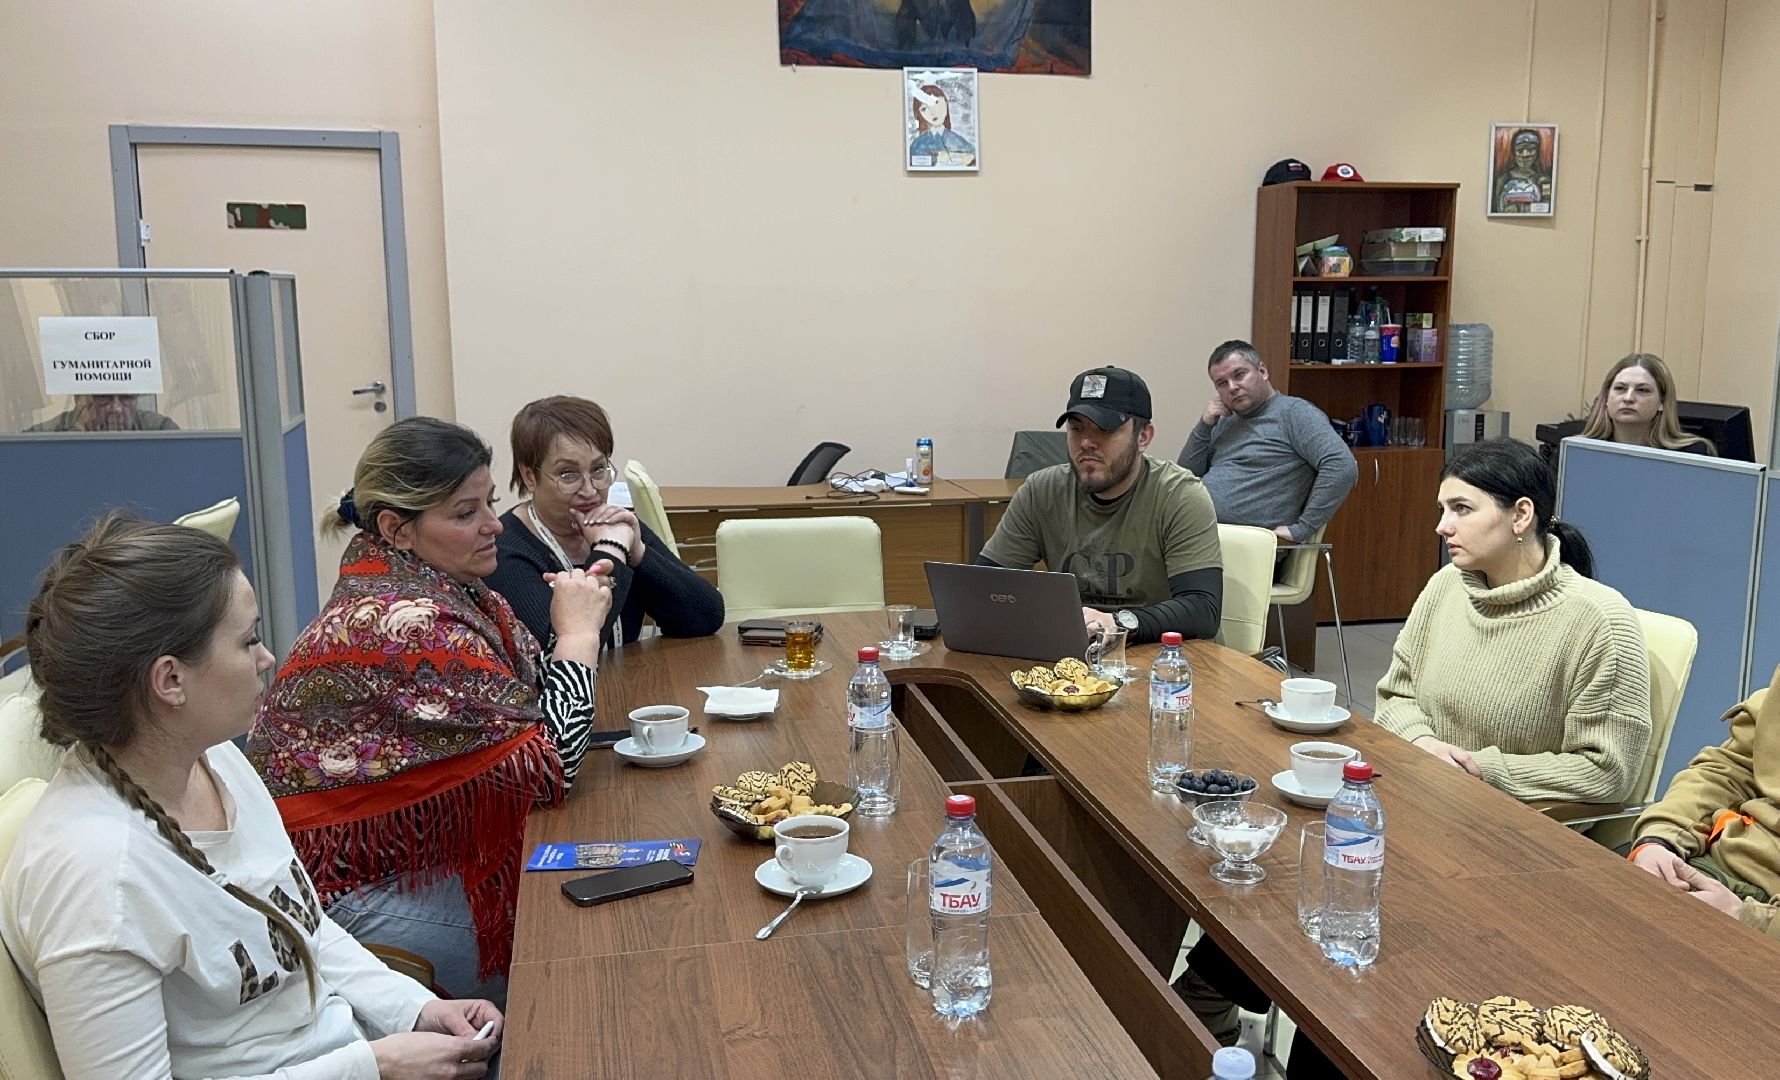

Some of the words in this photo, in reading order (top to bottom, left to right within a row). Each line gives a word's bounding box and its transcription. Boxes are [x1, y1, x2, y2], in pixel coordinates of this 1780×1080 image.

[84, 331, 116, 341] СБОР
[52, 359, 152, 370] ГУМАНИТАРНОЙ
[75, 372, 132, 382] ПОМОЩИ
[1341, 854, 1367, 864] ТБАУ
[939, 892, 982, 908] ТБАУ
